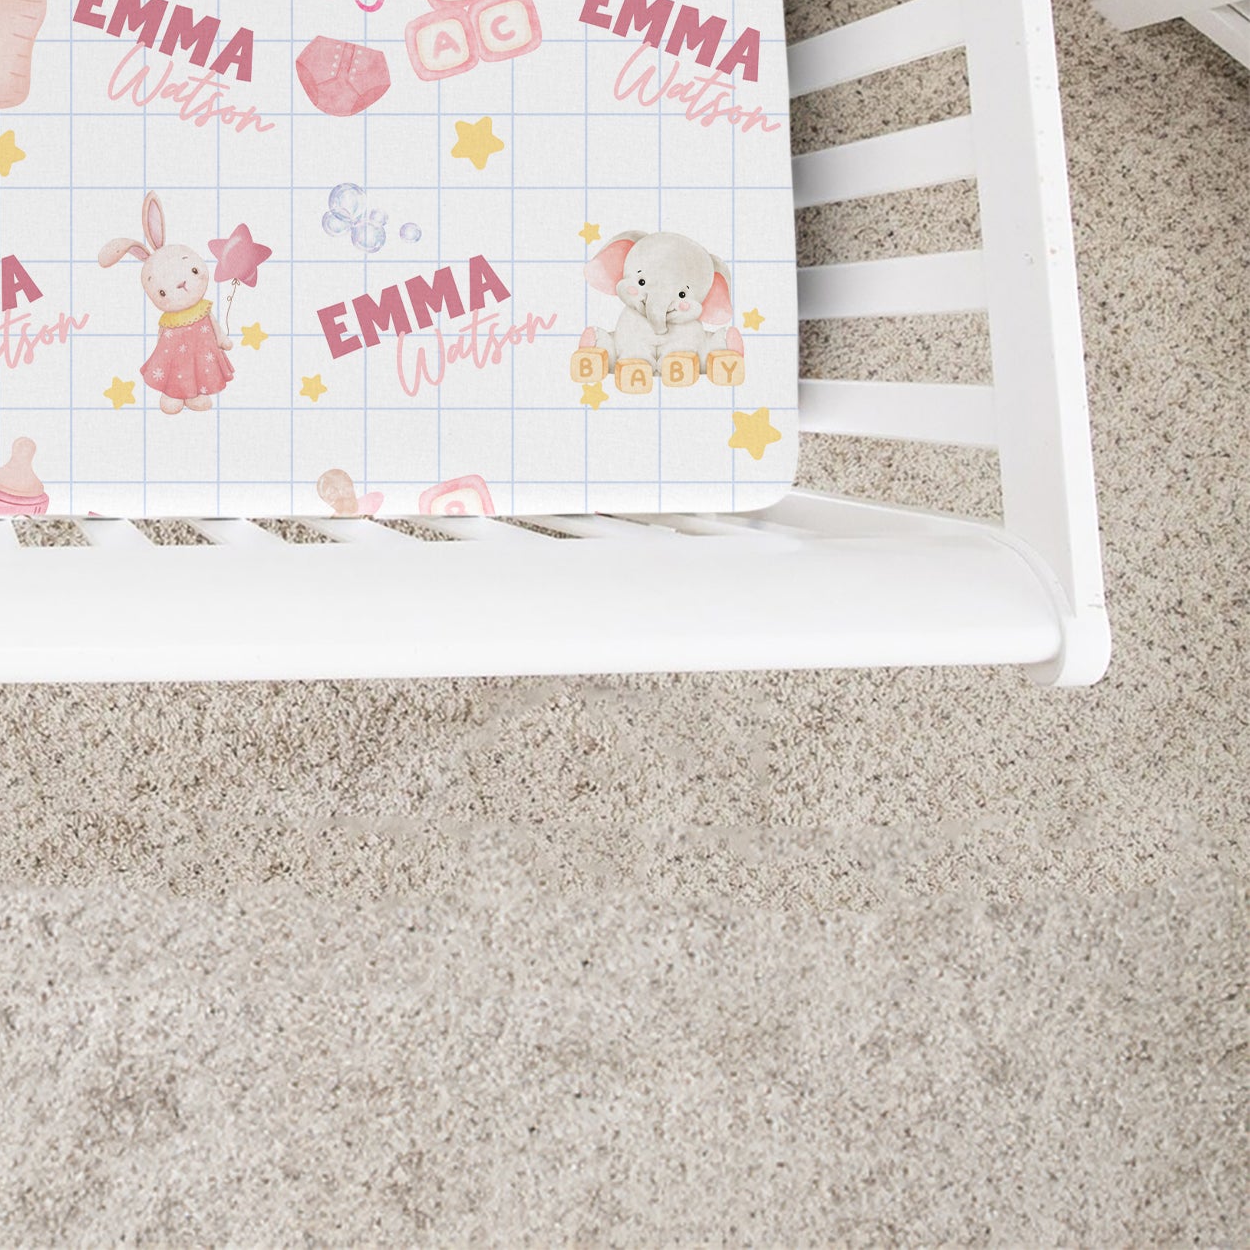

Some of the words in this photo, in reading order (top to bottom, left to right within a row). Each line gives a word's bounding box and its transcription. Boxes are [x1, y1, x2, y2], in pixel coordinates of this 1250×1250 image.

[107, 41, 276, 134] Watson
[613, 41, 782, 134] Watson
[317, 255, 511, 360] EMMA
[396, 309, 558, 398] Watson
